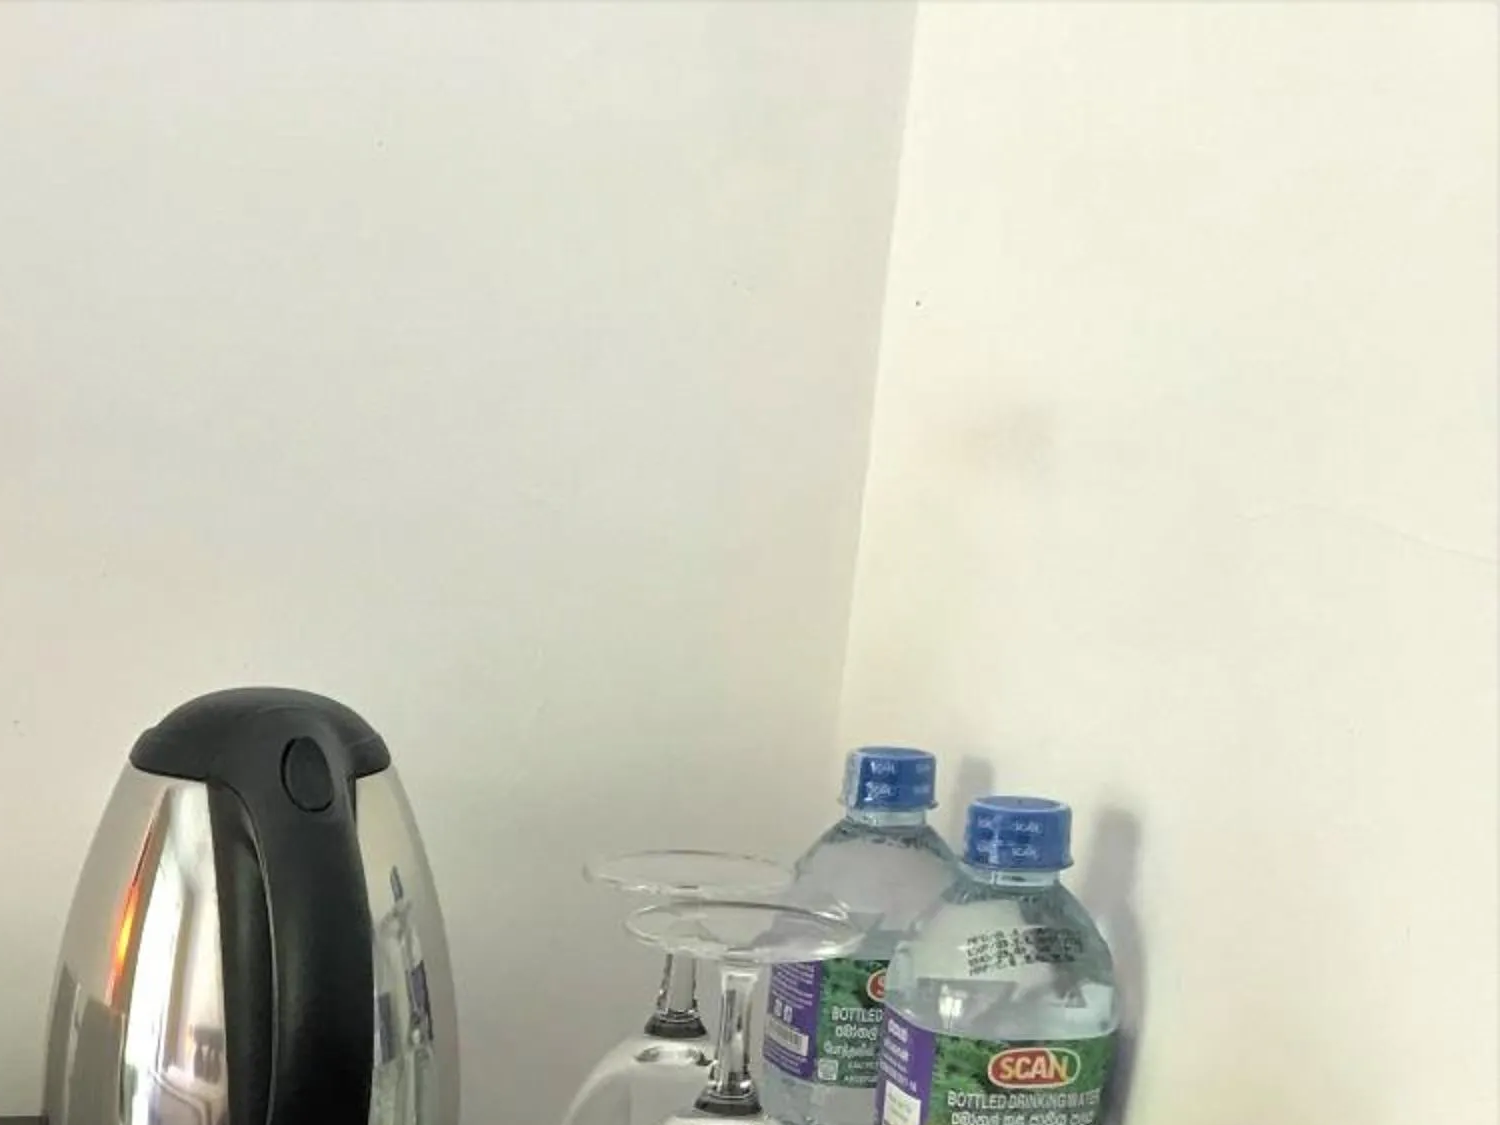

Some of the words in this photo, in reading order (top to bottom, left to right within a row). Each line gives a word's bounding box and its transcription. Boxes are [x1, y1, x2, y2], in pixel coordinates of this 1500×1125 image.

[831, 1006, 883, 1022] BOTTLED
[999, 1053, 1069, 1082] SCAN
[947, 1089, 1007, 1110] BOTTLED
[1008, 1092, 1066, 1110] DRINKING
